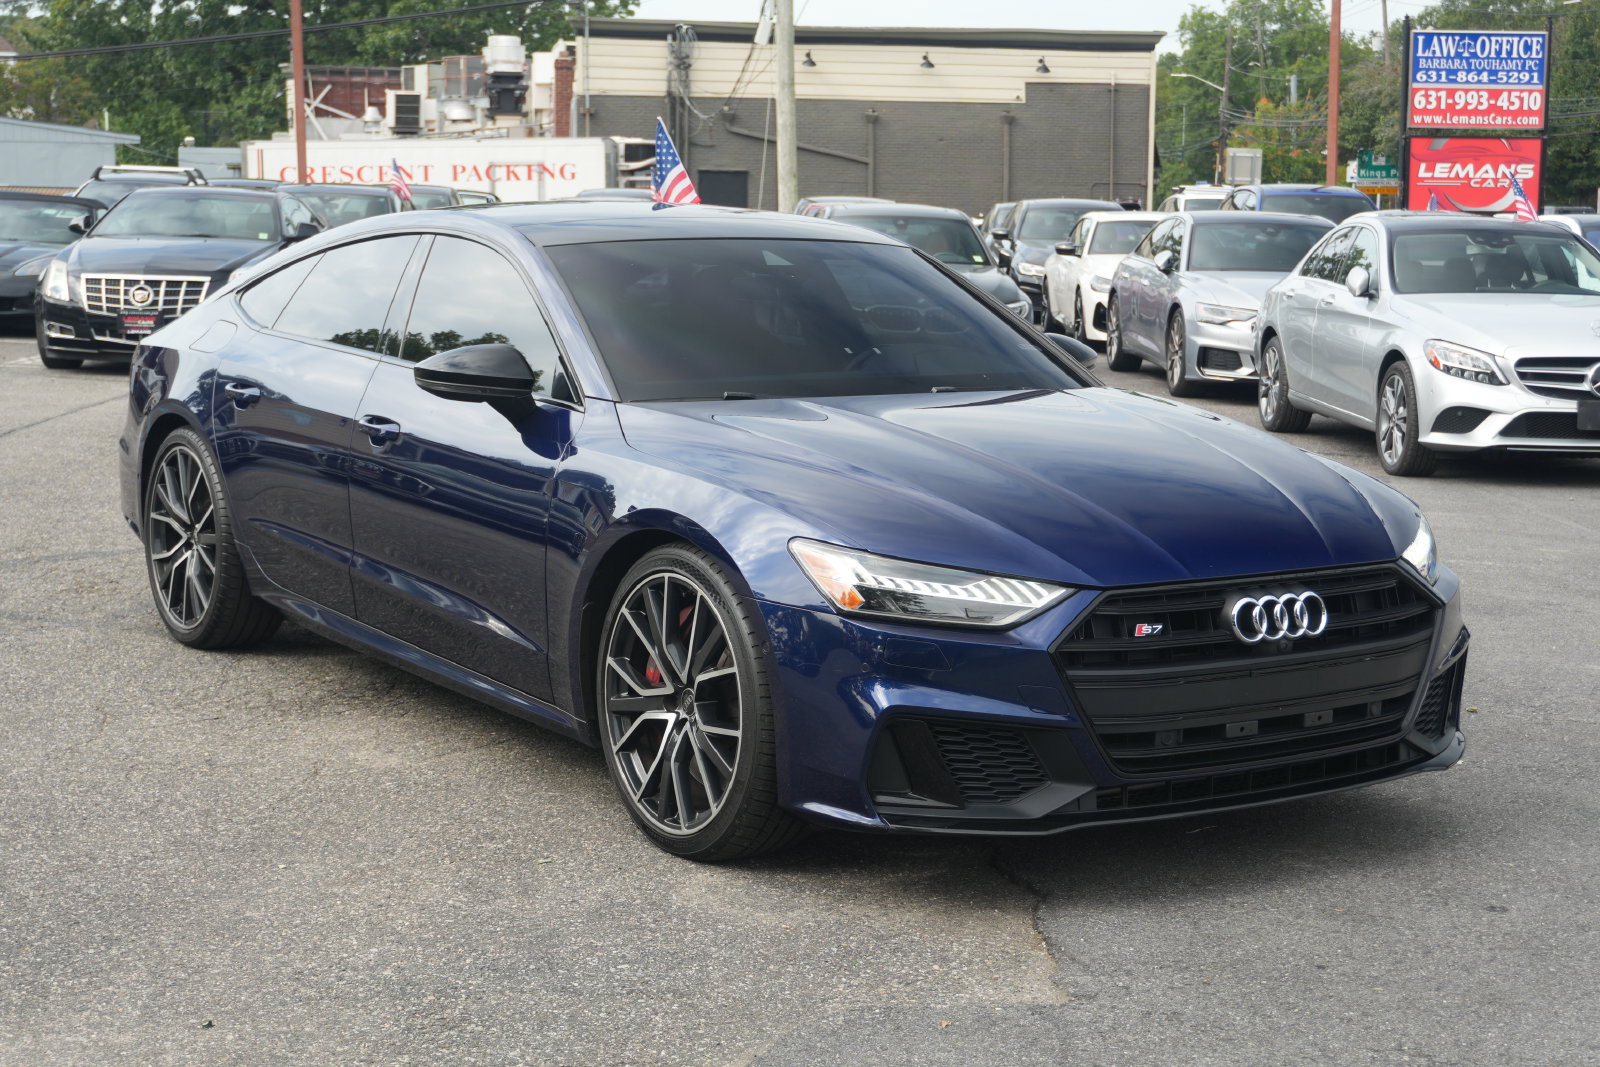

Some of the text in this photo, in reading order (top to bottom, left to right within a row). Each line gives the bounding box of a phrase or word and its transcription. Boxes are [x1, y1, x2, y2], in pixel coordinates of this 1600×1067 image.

[1417, 35, 1543, 59] LAW OFFICE
[1419, 58, 1539, 71] BARBARA TOUHAMY PC
[1416, 70, 1540, 84] 631-864-5291
[1413, 90, 1541, 111] 631-993-4510
[1413, 113, 1539, 125] www.LemansCars.com
[280, 163, 577, 184] CRESCENT PACKING
[1360, 169, 1386, 178] Kings
[1417, 163, 1535, 179] LEMANS
[1141, 625, 1162, 634] S7
